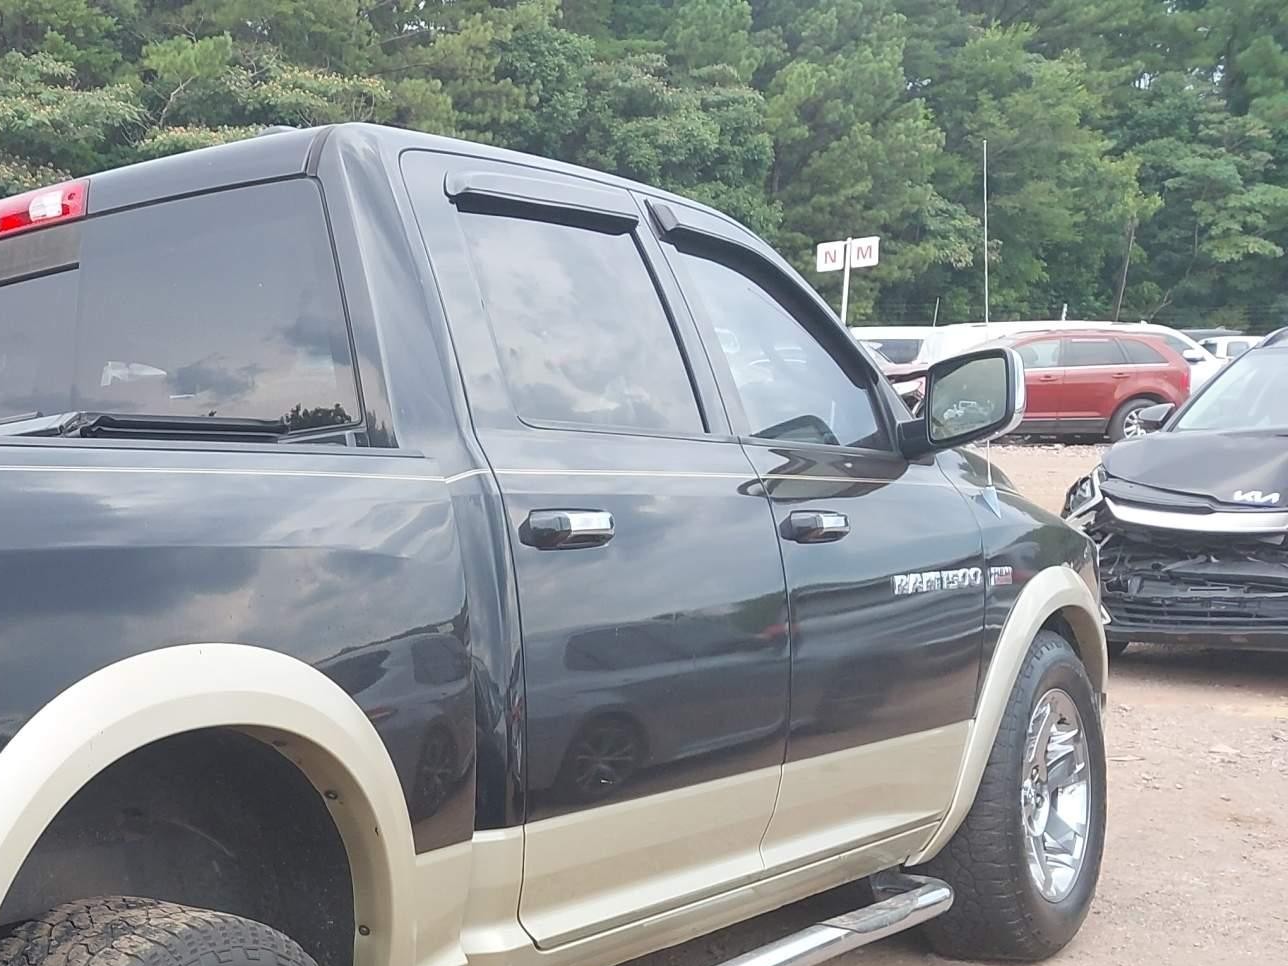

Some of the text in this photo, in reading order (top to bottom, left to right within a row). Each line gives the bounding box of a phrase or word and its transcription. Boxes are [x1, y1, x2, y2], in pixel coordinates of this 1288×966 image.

[824, 249, 837, 265] N
[856, 245, 872, 261] M
[941, 567, 982, 590] 1500
